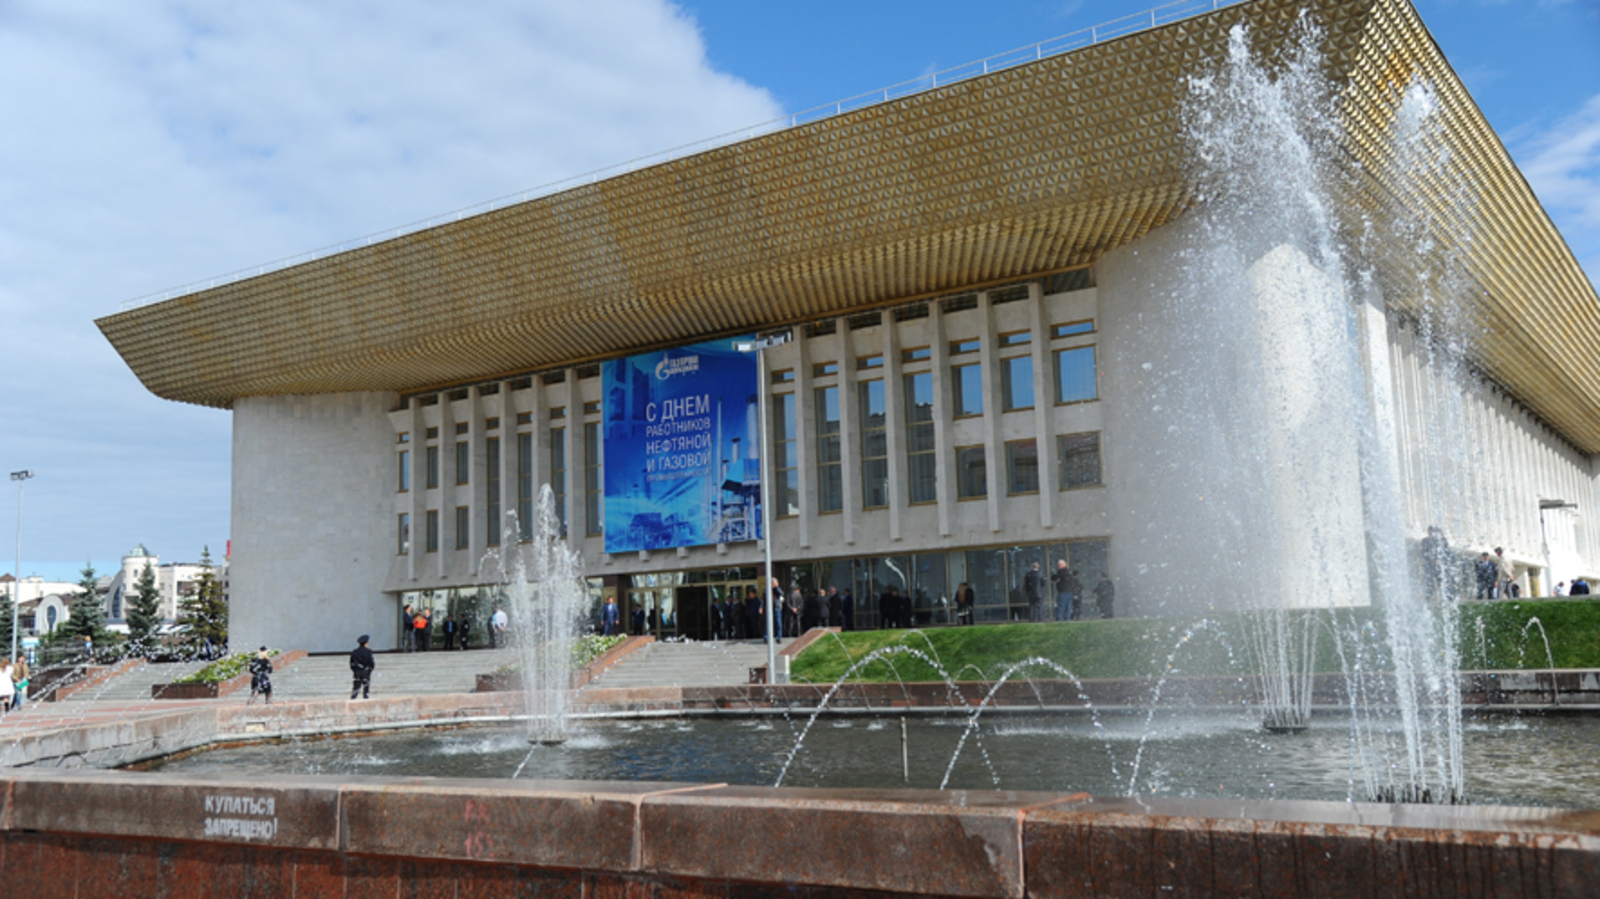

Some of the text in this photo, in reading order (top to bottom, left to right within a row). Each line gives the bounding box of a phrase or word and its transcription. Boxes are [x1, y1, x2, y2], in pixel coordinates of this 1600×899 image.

[646, 394, 710, 423] С ДНЕМ
[646, 417, 711, 437] РАБОТНИКОВ
[646, 431, 711, 455] НЕФТЯНОЙ
[646, 449, 711, 472] И ГАЗОВОЙ
[204, 795, 275, 815] КУПАТЬСЯ
[204, 817, 278, 841] ЗАПРЕЩЕНО!
